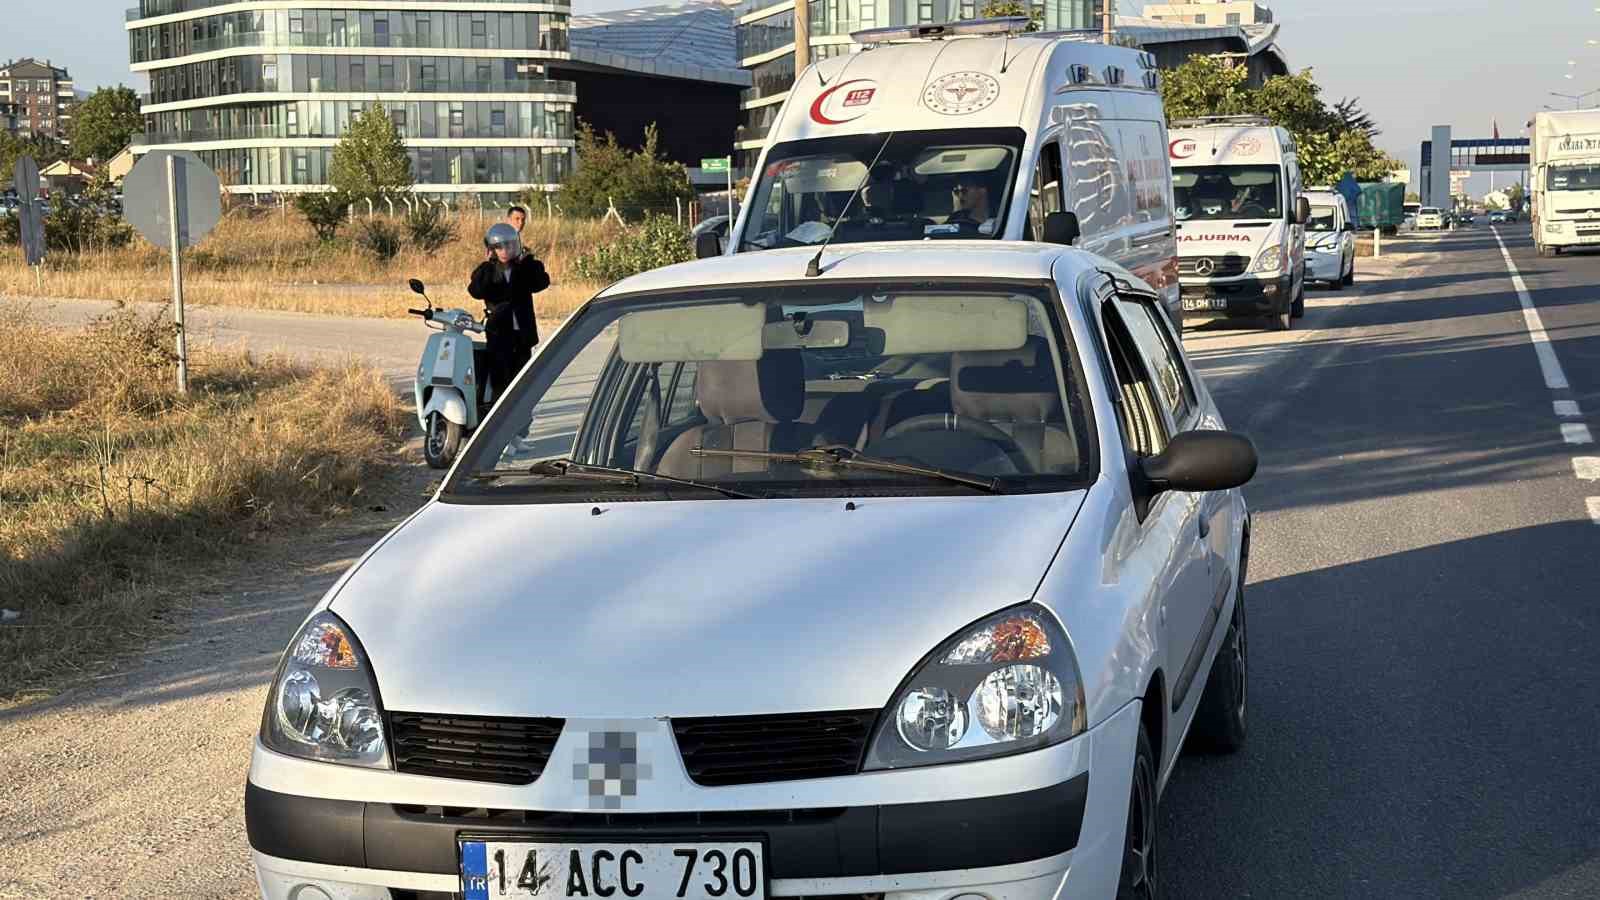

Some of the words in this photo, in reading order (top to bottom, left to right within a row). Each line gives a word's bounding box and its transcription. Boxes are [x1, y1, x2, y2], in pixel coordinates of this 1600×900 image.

[852, 91, 871, 99] 112
[1185, 299, 1194, 307] 14
[494, 849, 538, 895] 14
[566, 849, 643, 897] ACC
[673, 848, 757, 897] 730
[469, 876, 486, 891] TR
